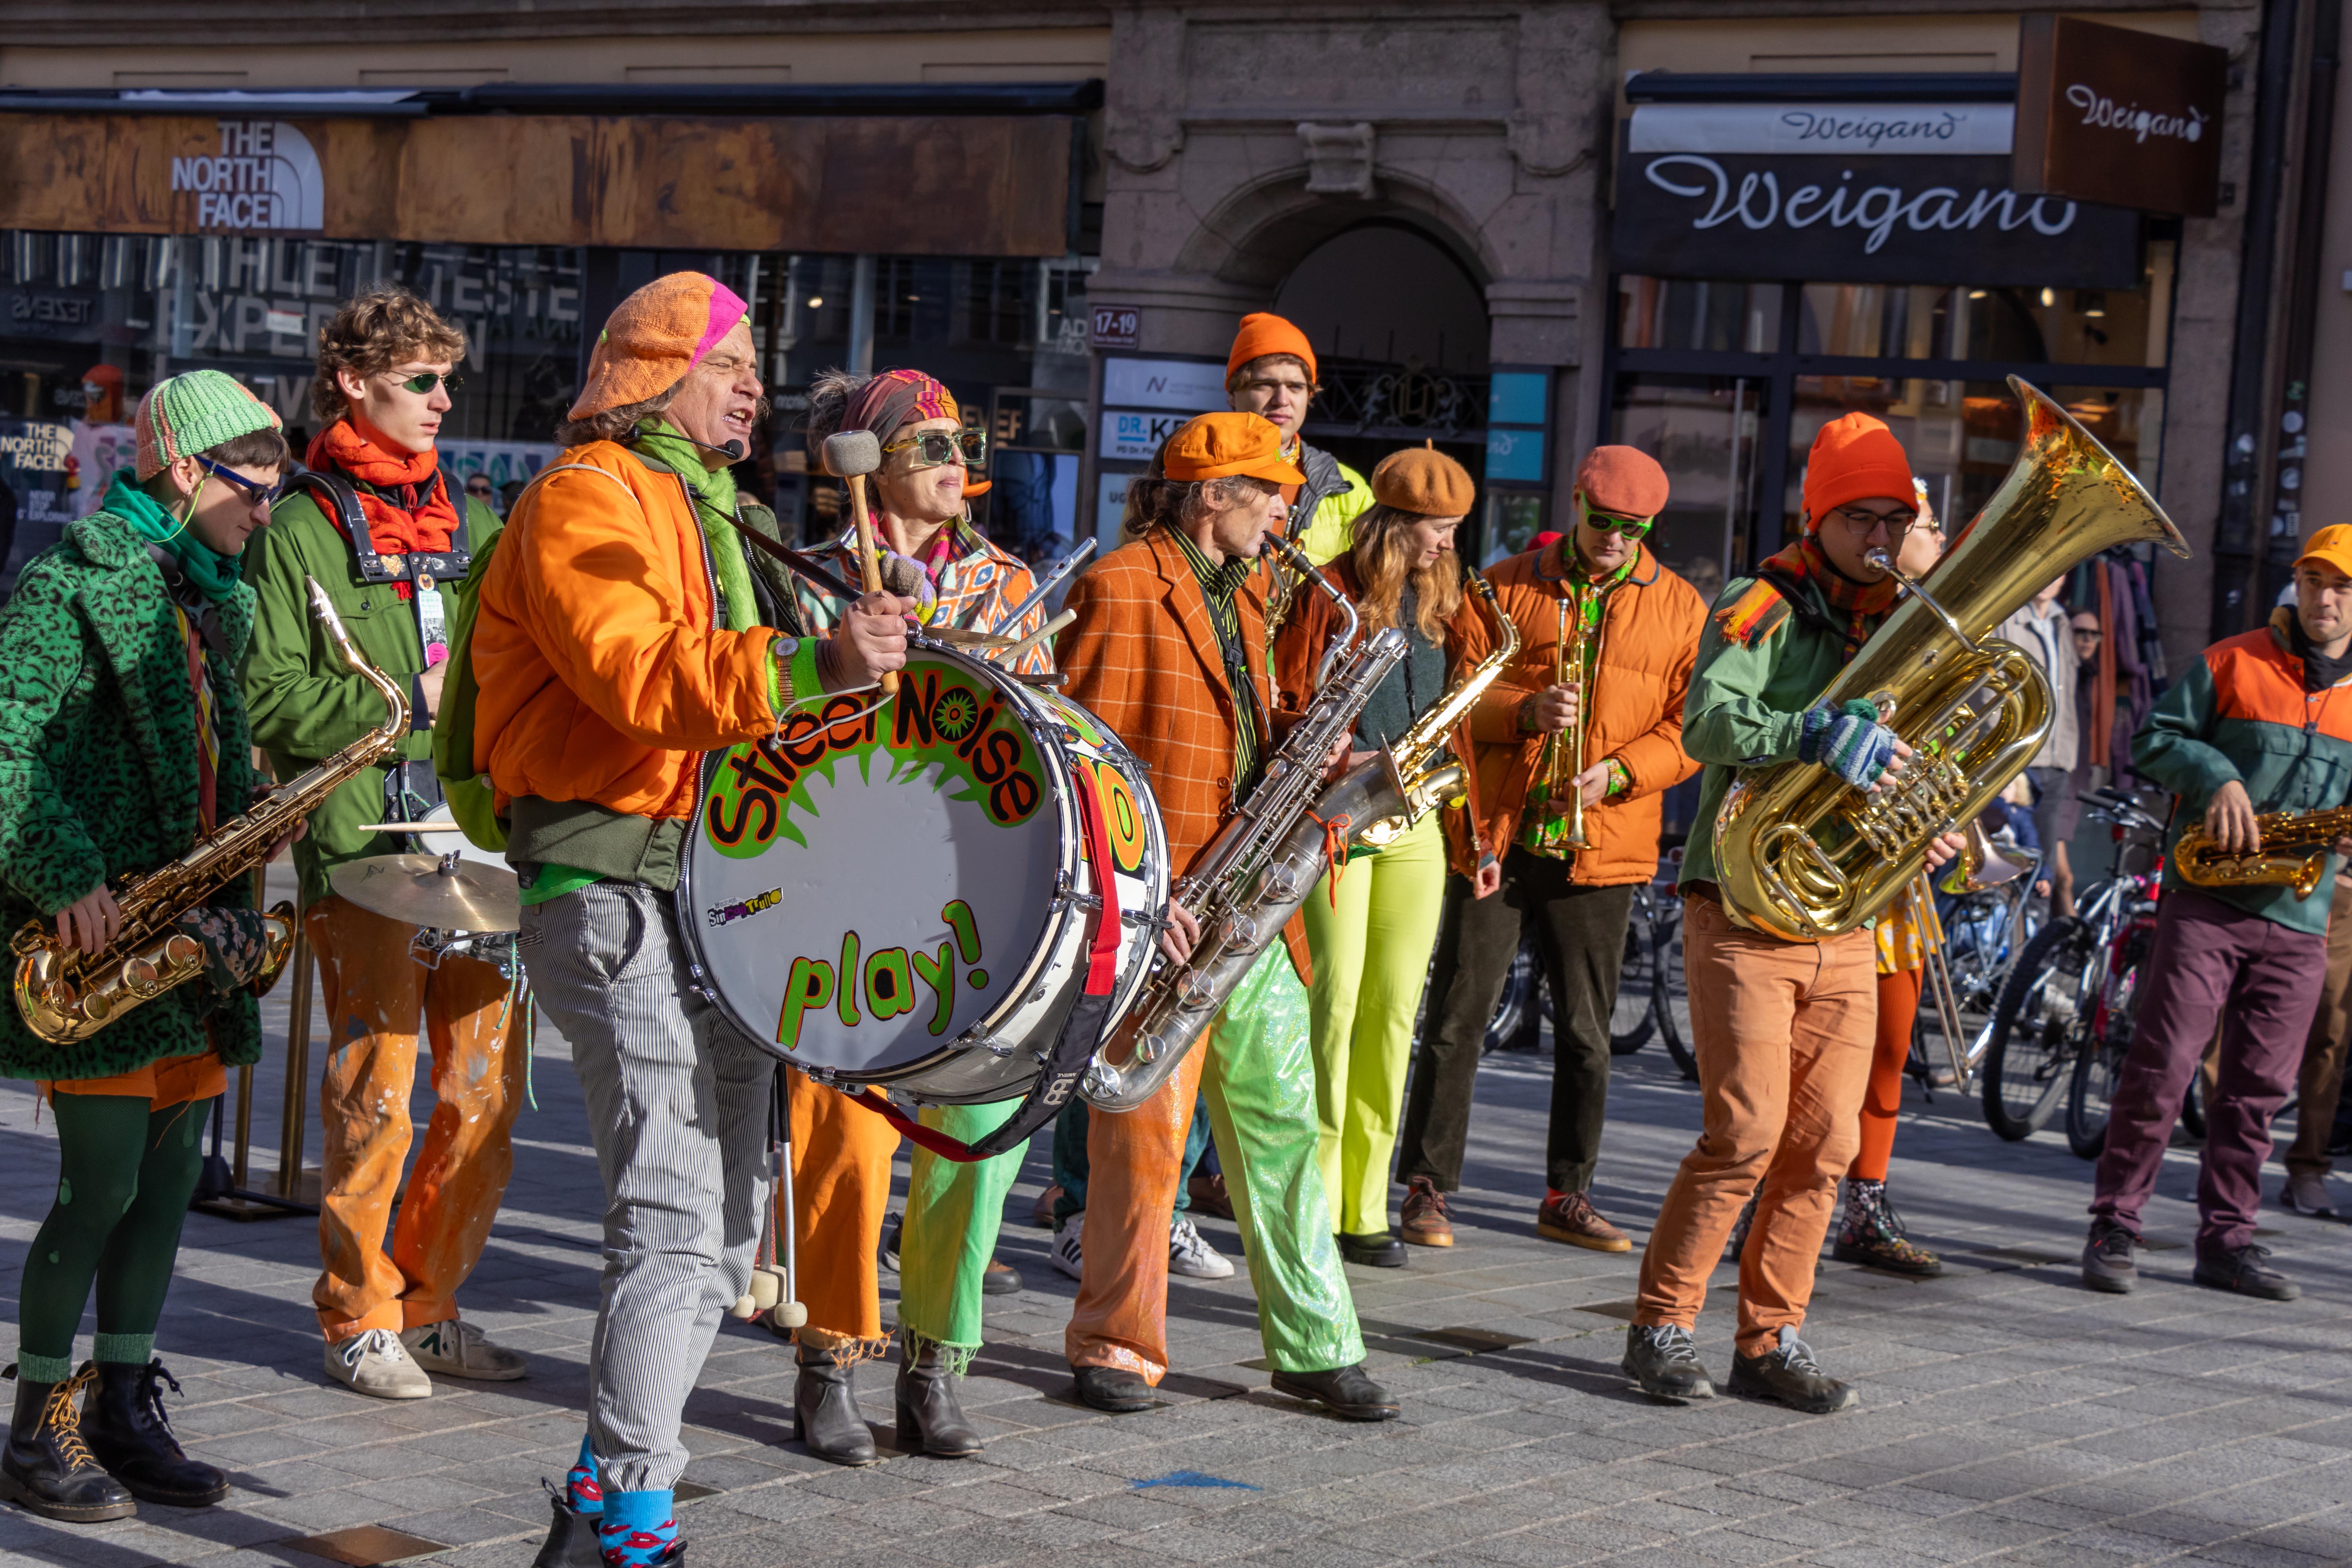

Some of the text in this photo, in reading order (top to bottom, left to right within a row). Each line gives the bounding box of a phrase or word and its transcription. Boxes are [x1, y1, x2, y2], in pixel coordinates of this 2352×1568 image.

[1781, 111, 1966, 149] Weigand
[2065, 83, 2210, 144] Weigand
[217, 121, 274, 156] THE
[171, 157, 272, 192] NORTH
[198, 192, 271, 229] FACE
[1096, 312, 1136, 335] 17-19
[25, 423, 56, 440] THE
[1118, 416, 1147, 434] DR.
[0, 436, 55, 454] NORTH
[15, 452, 54, 471] FACE
[777, 899, 989, 1051] play!
